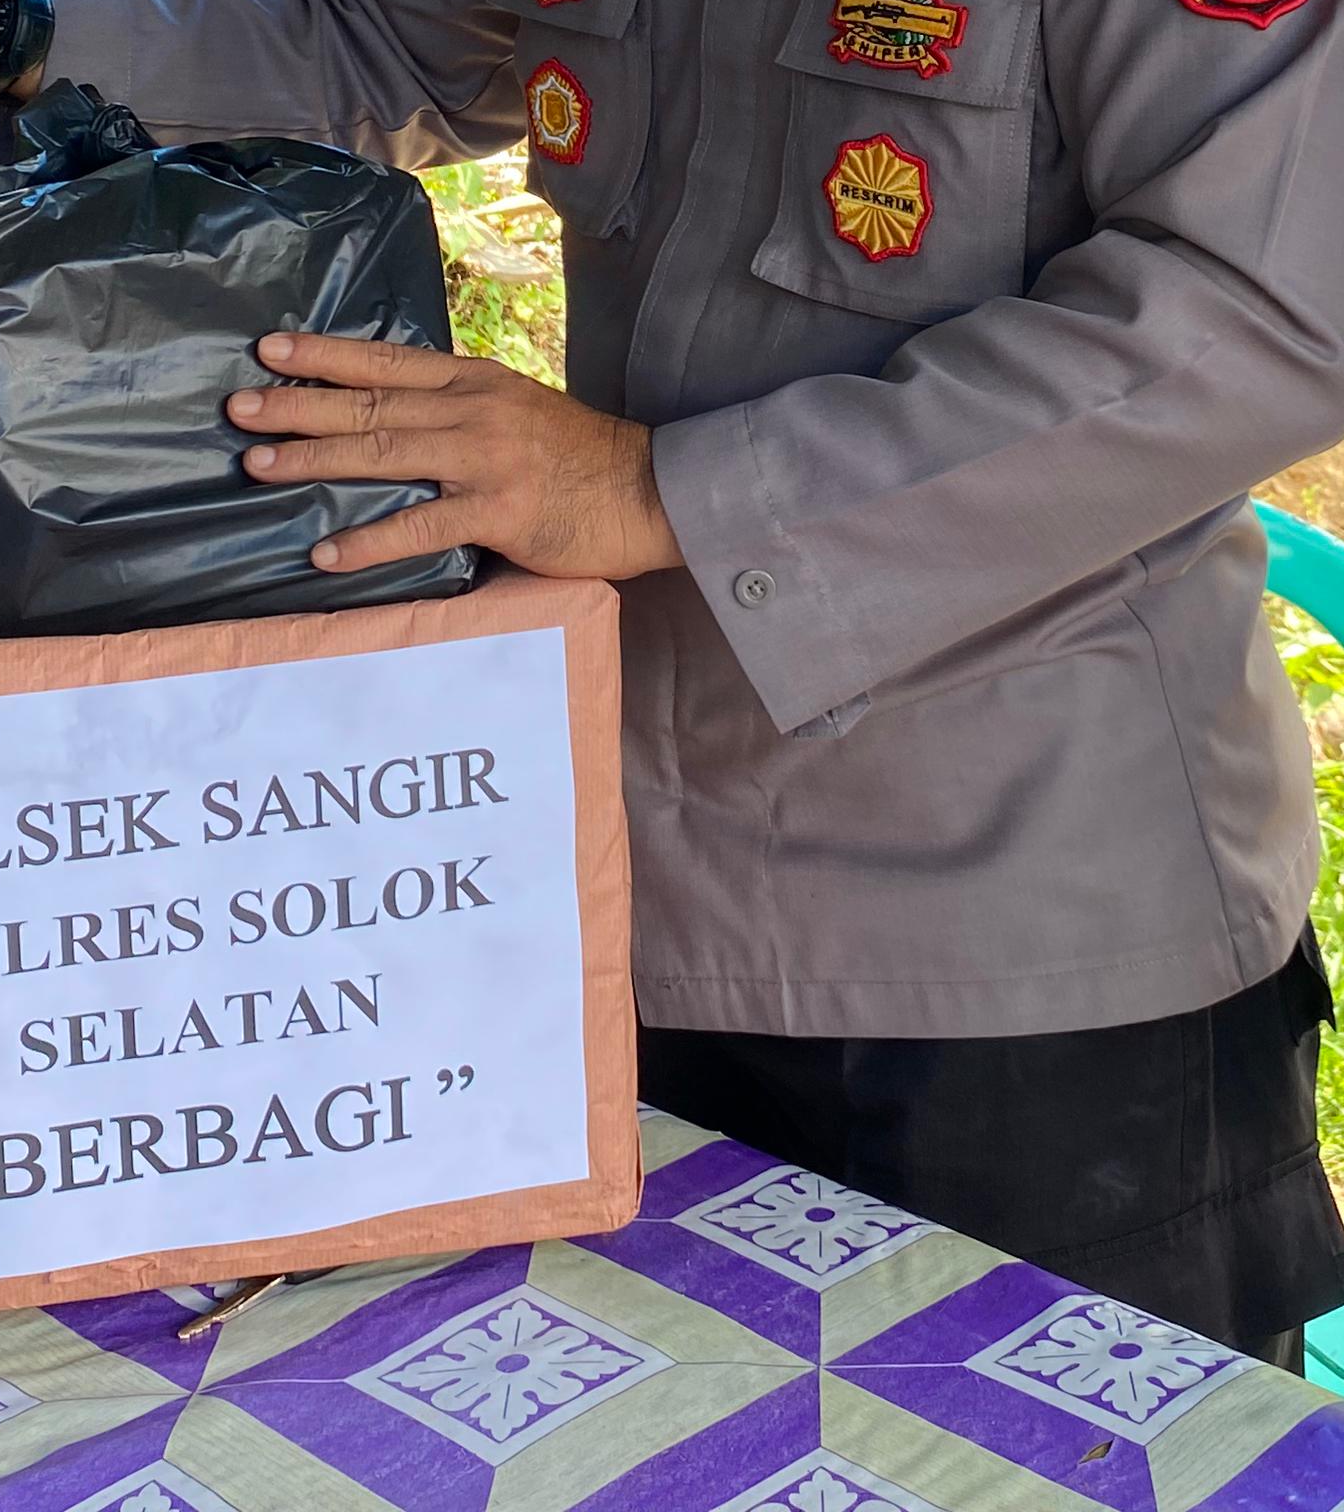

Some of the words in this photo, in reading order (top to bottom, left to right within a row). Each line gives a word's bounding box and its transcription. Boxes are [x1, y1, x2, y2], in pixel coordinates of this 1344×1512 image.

[843, 36, 922, 61] SNIPER
[840, 183, 914, 214] RESKRIM
[202, 746, 509, 845] SANGIR
[227, 854, 496, 946] SOLOK
[19, 972, 383, 1076] SELATAN
